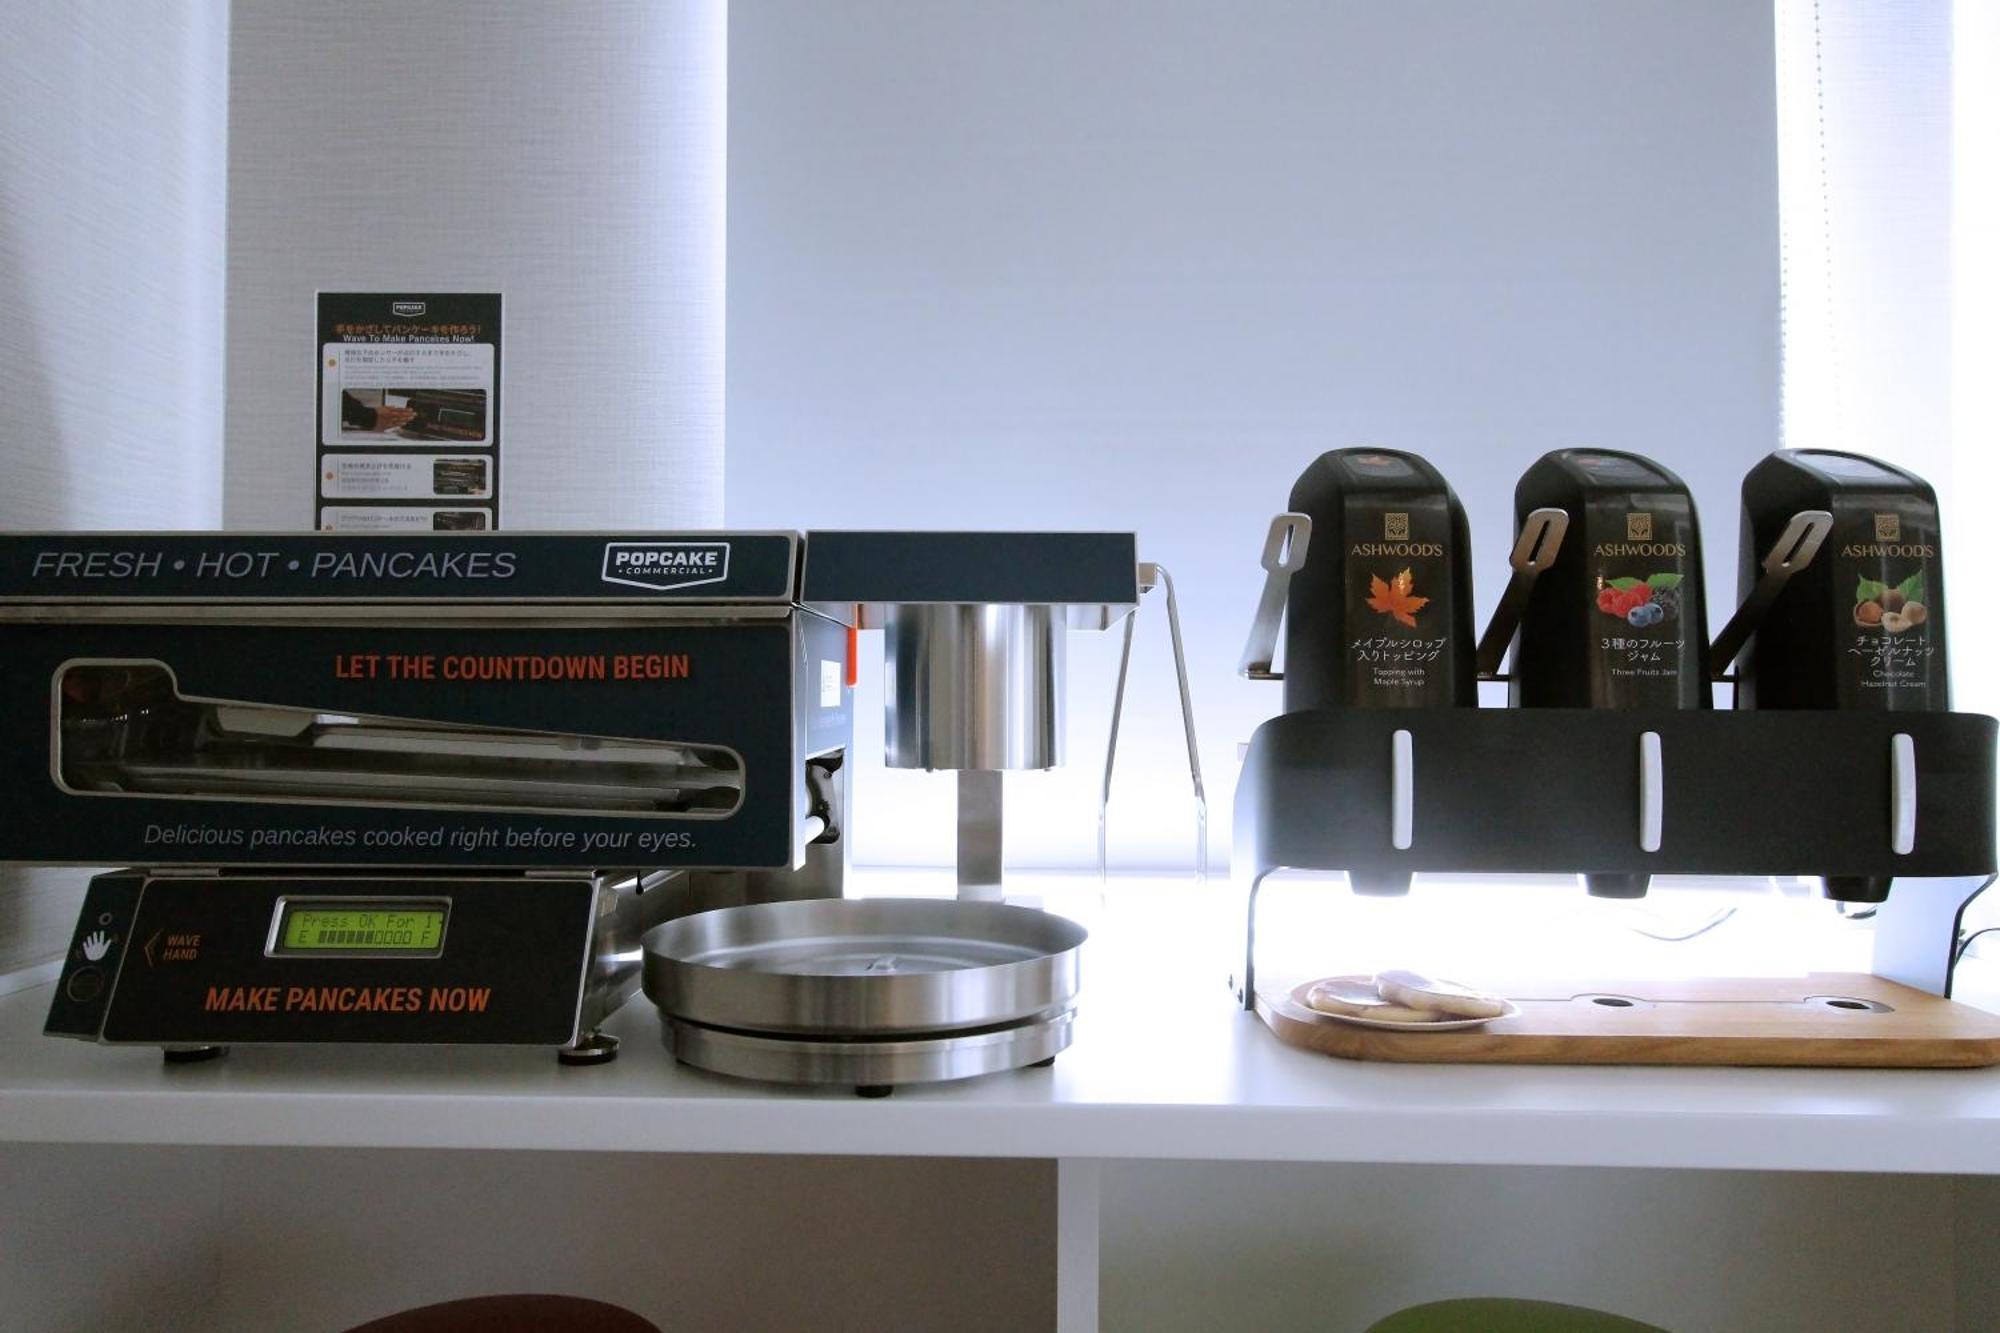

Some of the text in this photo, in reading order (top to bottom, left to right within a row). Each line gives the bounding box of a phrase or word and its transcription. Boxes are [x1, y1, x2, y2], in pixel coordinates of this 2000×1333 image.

[343, 334, 367, 343] Wave
[370, 334, 381, 343] To
[383, 334, 406, 343] Make
[409, 334, 450, 343] Pancakes
[615, 551, 719, 567] POPCAKE
[32, 552, 517, 579] FRESH HOT PANCAKES
[625, 567, 706, 575] COMMERCIAL
[1351, 637, 1447, 649] メイプルシロップ
[1857, 636, 1926, 646] チョコレート
[1357, 649, 1440, 661] 入りトッピング
[1627, 650, 1661, 661] ジャム
[1847, 646, 1934, 657] ヘーゼルナッツ
[335, 654, 690, 680] LET THE COUNTDOWN BEGIN
[1870, 656, 1917, 667] クリーム
[1373, 667, 1425, 676] Topping with
[1612, 668, 1635, 676] Three
[144, 824, 697, 852] Delicious pancakes cooked right before your eyes.
[302, 914, 347, 928] Press
[359, 915, 378, 928] OK
[387, 915, 415, 928] For
[167, 934, 201, 946] WAVE
[163, 948, 198, 960] HAND
[205, 987, 491, 1011] MAKE PANCAKES NOW
